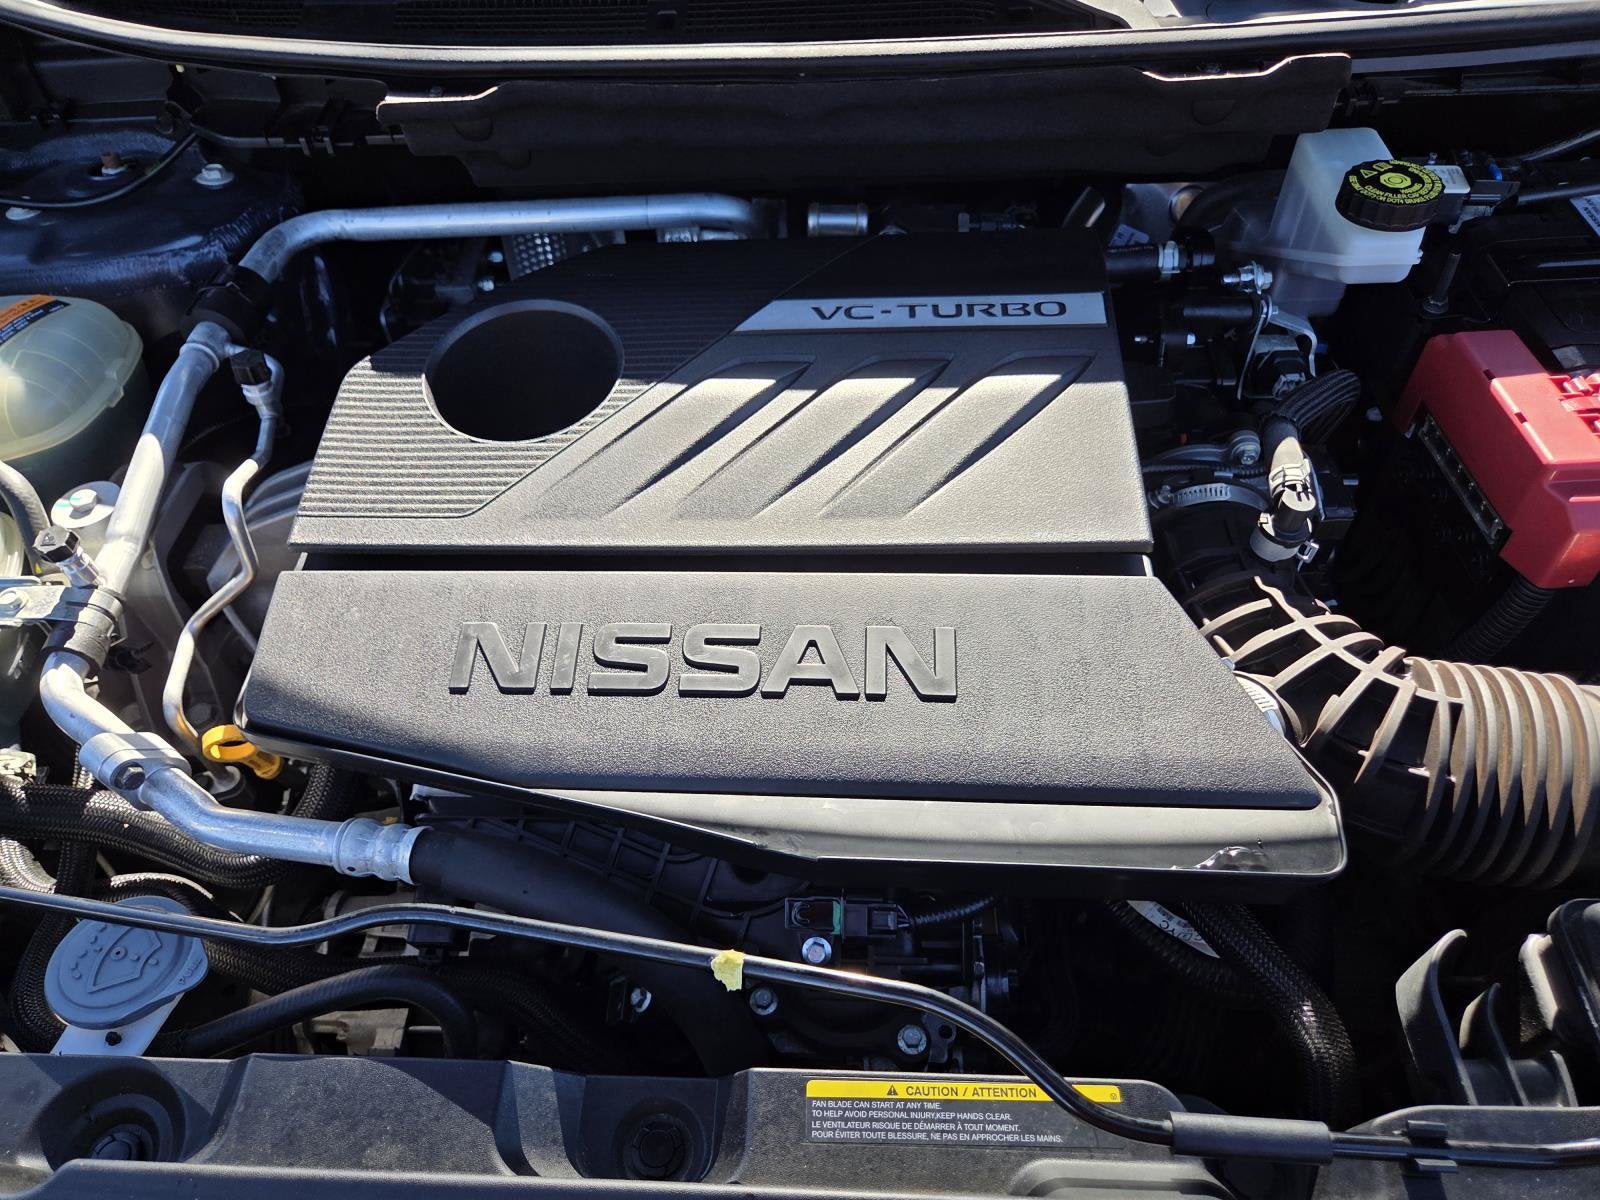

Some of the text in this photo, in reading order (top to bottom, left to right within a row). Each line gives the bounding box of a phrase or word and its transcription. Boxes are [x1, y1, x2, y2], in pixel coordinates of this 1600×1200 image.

[811, 301, 1067, 321] VC-TURBO
[448, 620, 958, 702] NISSAN
[905, 1085, 958, 1096] CAUTION
[972, 1087, 1037, 1098] ATTENTION
[811, 1100, 826, 1108] FAN
[827, 1100, 852, 1108] BLADE
[871, 1101, 894, 1109] START
[923, 1102, 942, 1110] TIME.
[823, 1110, 843, 1118] HELP
[844, 1110, 867, 1118] AVOID
[868, 1111, 909, 1119] PERSONAL
[985, 1113, 1012, 1121] CLEAR.
[822, 1121, 871, 1129] VENTILATEUR
[872, 1122, 901, 1130] RISQUE
[902, 1122, 912, 1130] DE
[914, 1121, 956, 1131] DÉMARRER
[957, 1121, 963, 1131] À
[964, 1123, 984, 1131] TOUT
[985, 1124, 1021, 1132] MOMENT.
[811, 1131, 834, 1139] POUR
[836, 1129, 861, 1139] ÉVITER
[887, 1132, 929, 1141] BLESSURE,
[960, 1133, 970, 1141] EN
[972, 1133, 1019, 1142] APPROCHER
[1021, 1134, 1036, 1142] LES
[1036, 1135, 1064, 1143] MAINS.
